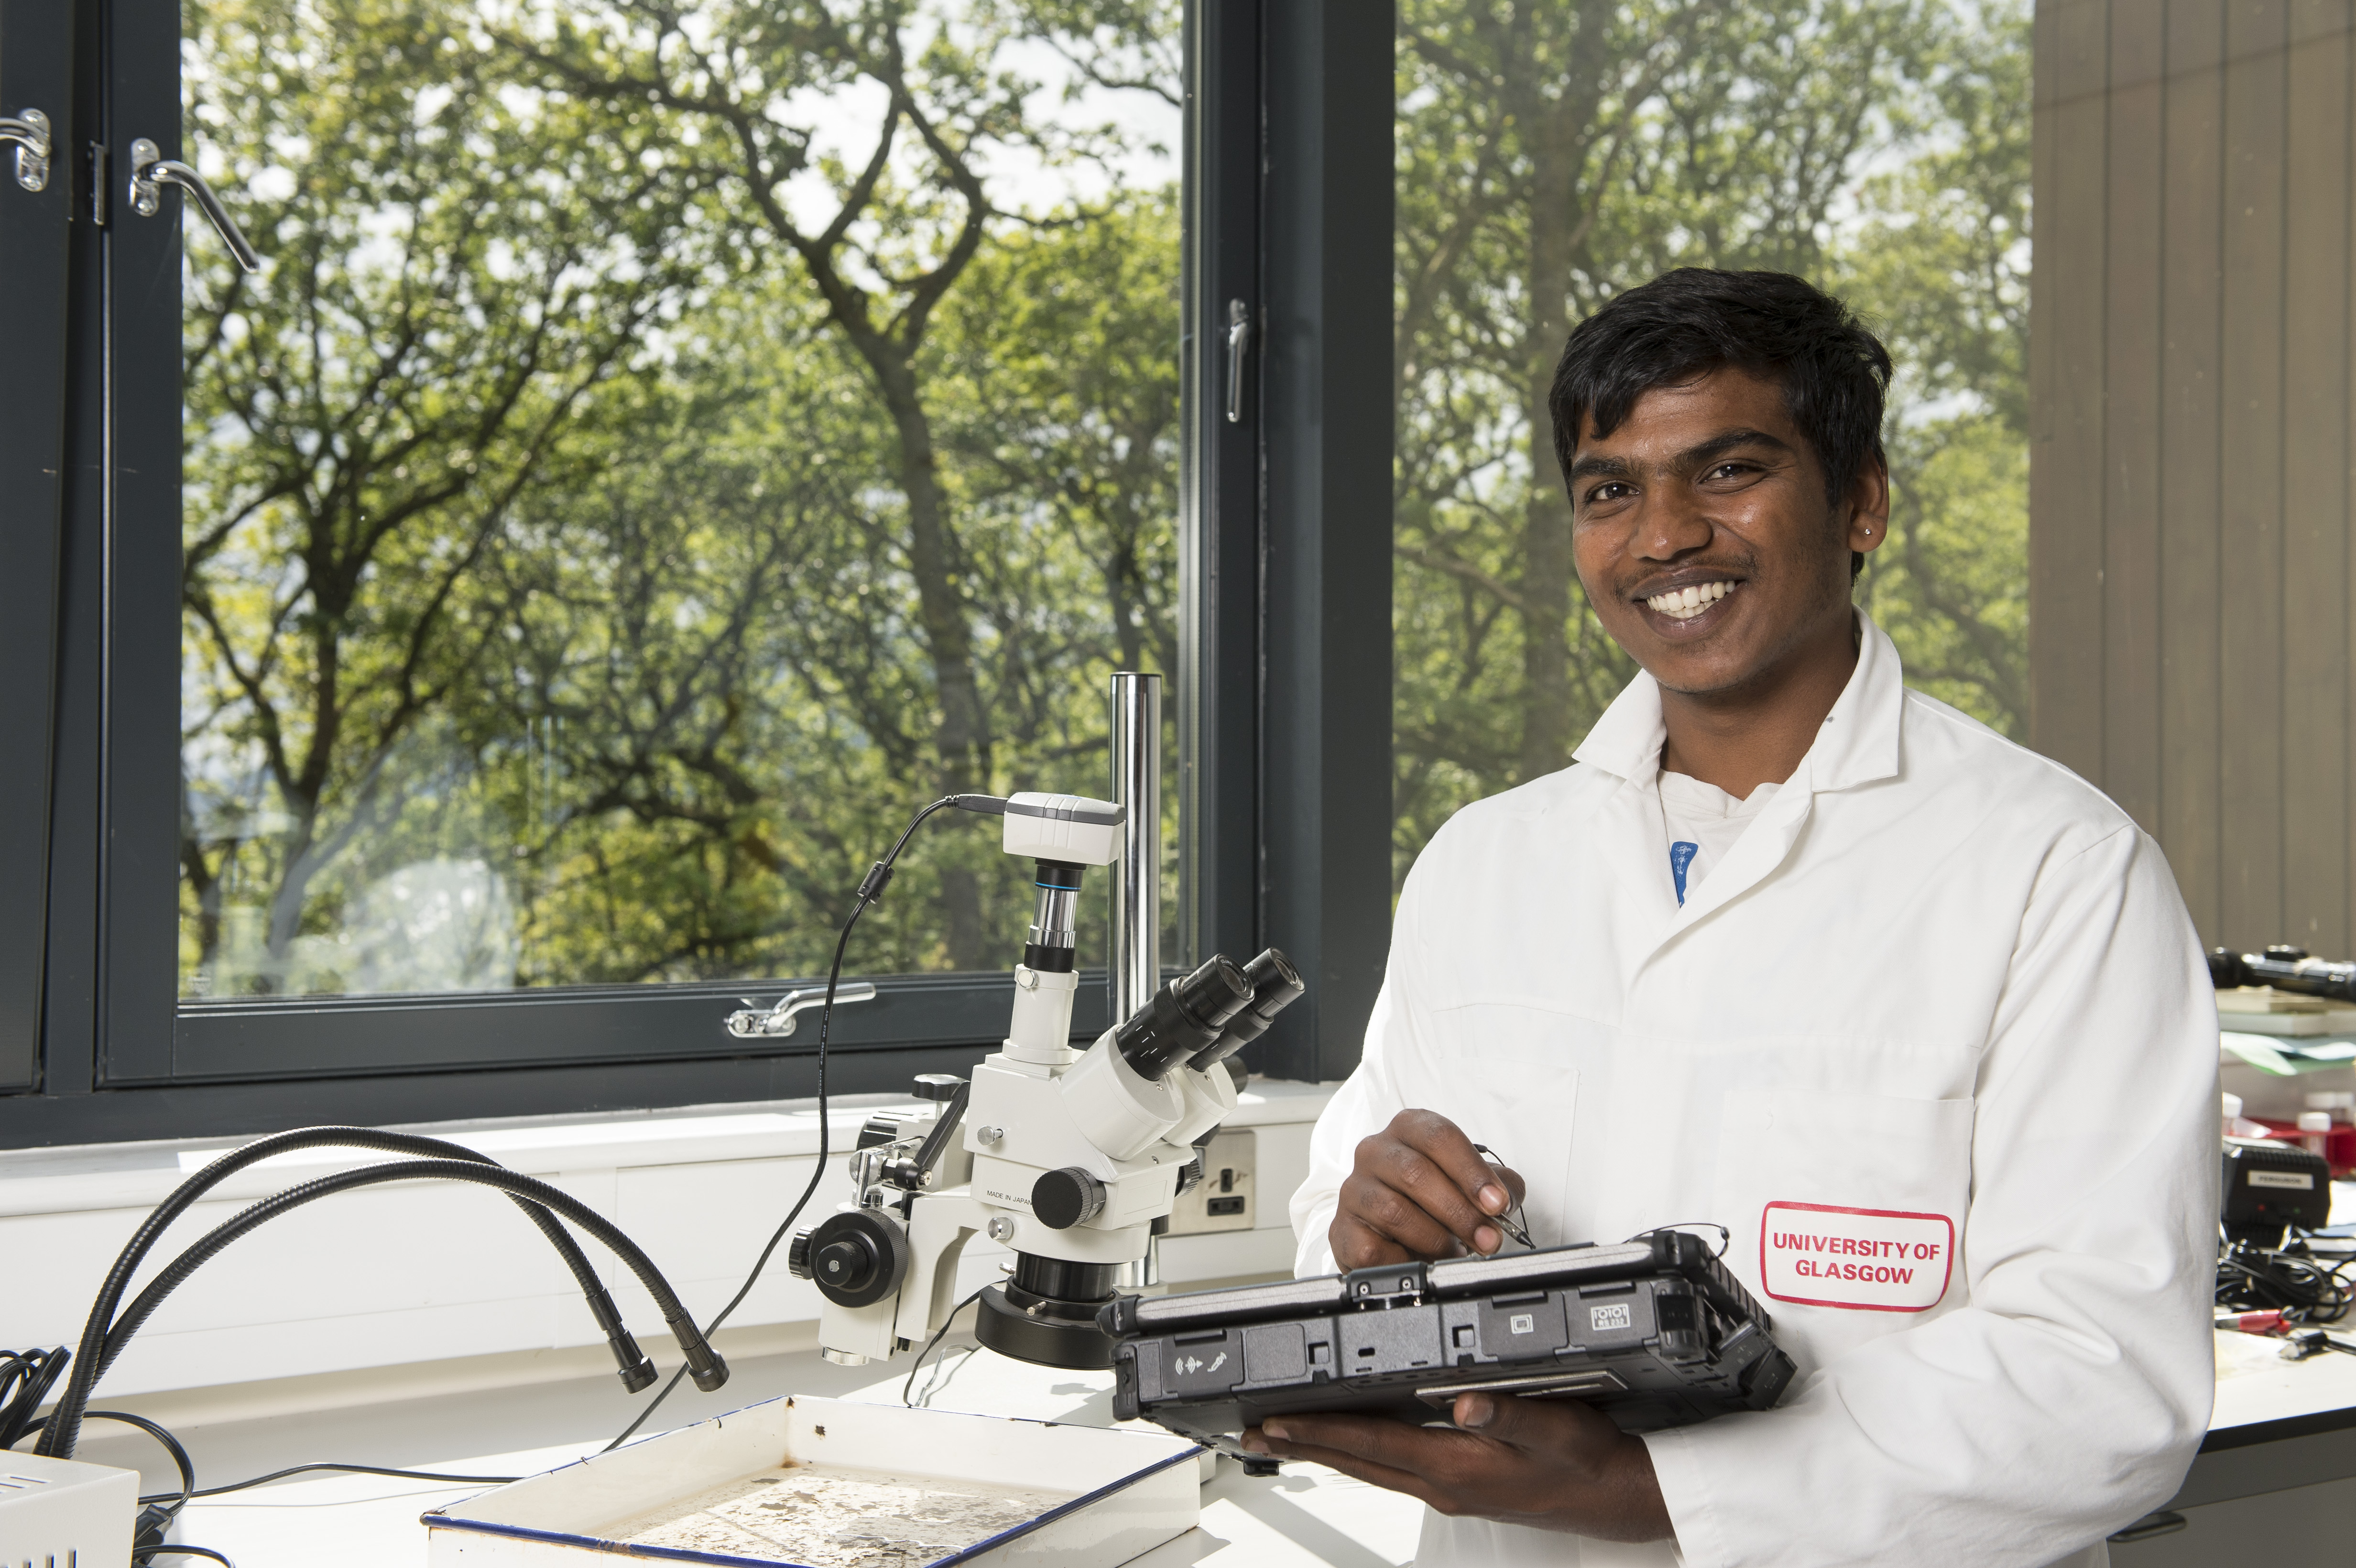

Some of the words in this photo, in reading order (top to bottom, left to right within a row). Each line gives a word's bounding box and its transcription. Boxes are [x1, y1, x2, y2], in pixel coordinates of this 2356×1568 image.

[987, 1190, 1003, 1199] MADE
[1013, 1197, 1032, 1205] JAPAN
[1774, 1232, 1909, 1259] UNIVERSITY
[1914, 1243, 1940, 1260] OF
[1796, 1260, 1914, 1284] GLASGOW
[1598, 1318, 1610, 1327] RS
[1610, 1317, 1624, 1326] 232
